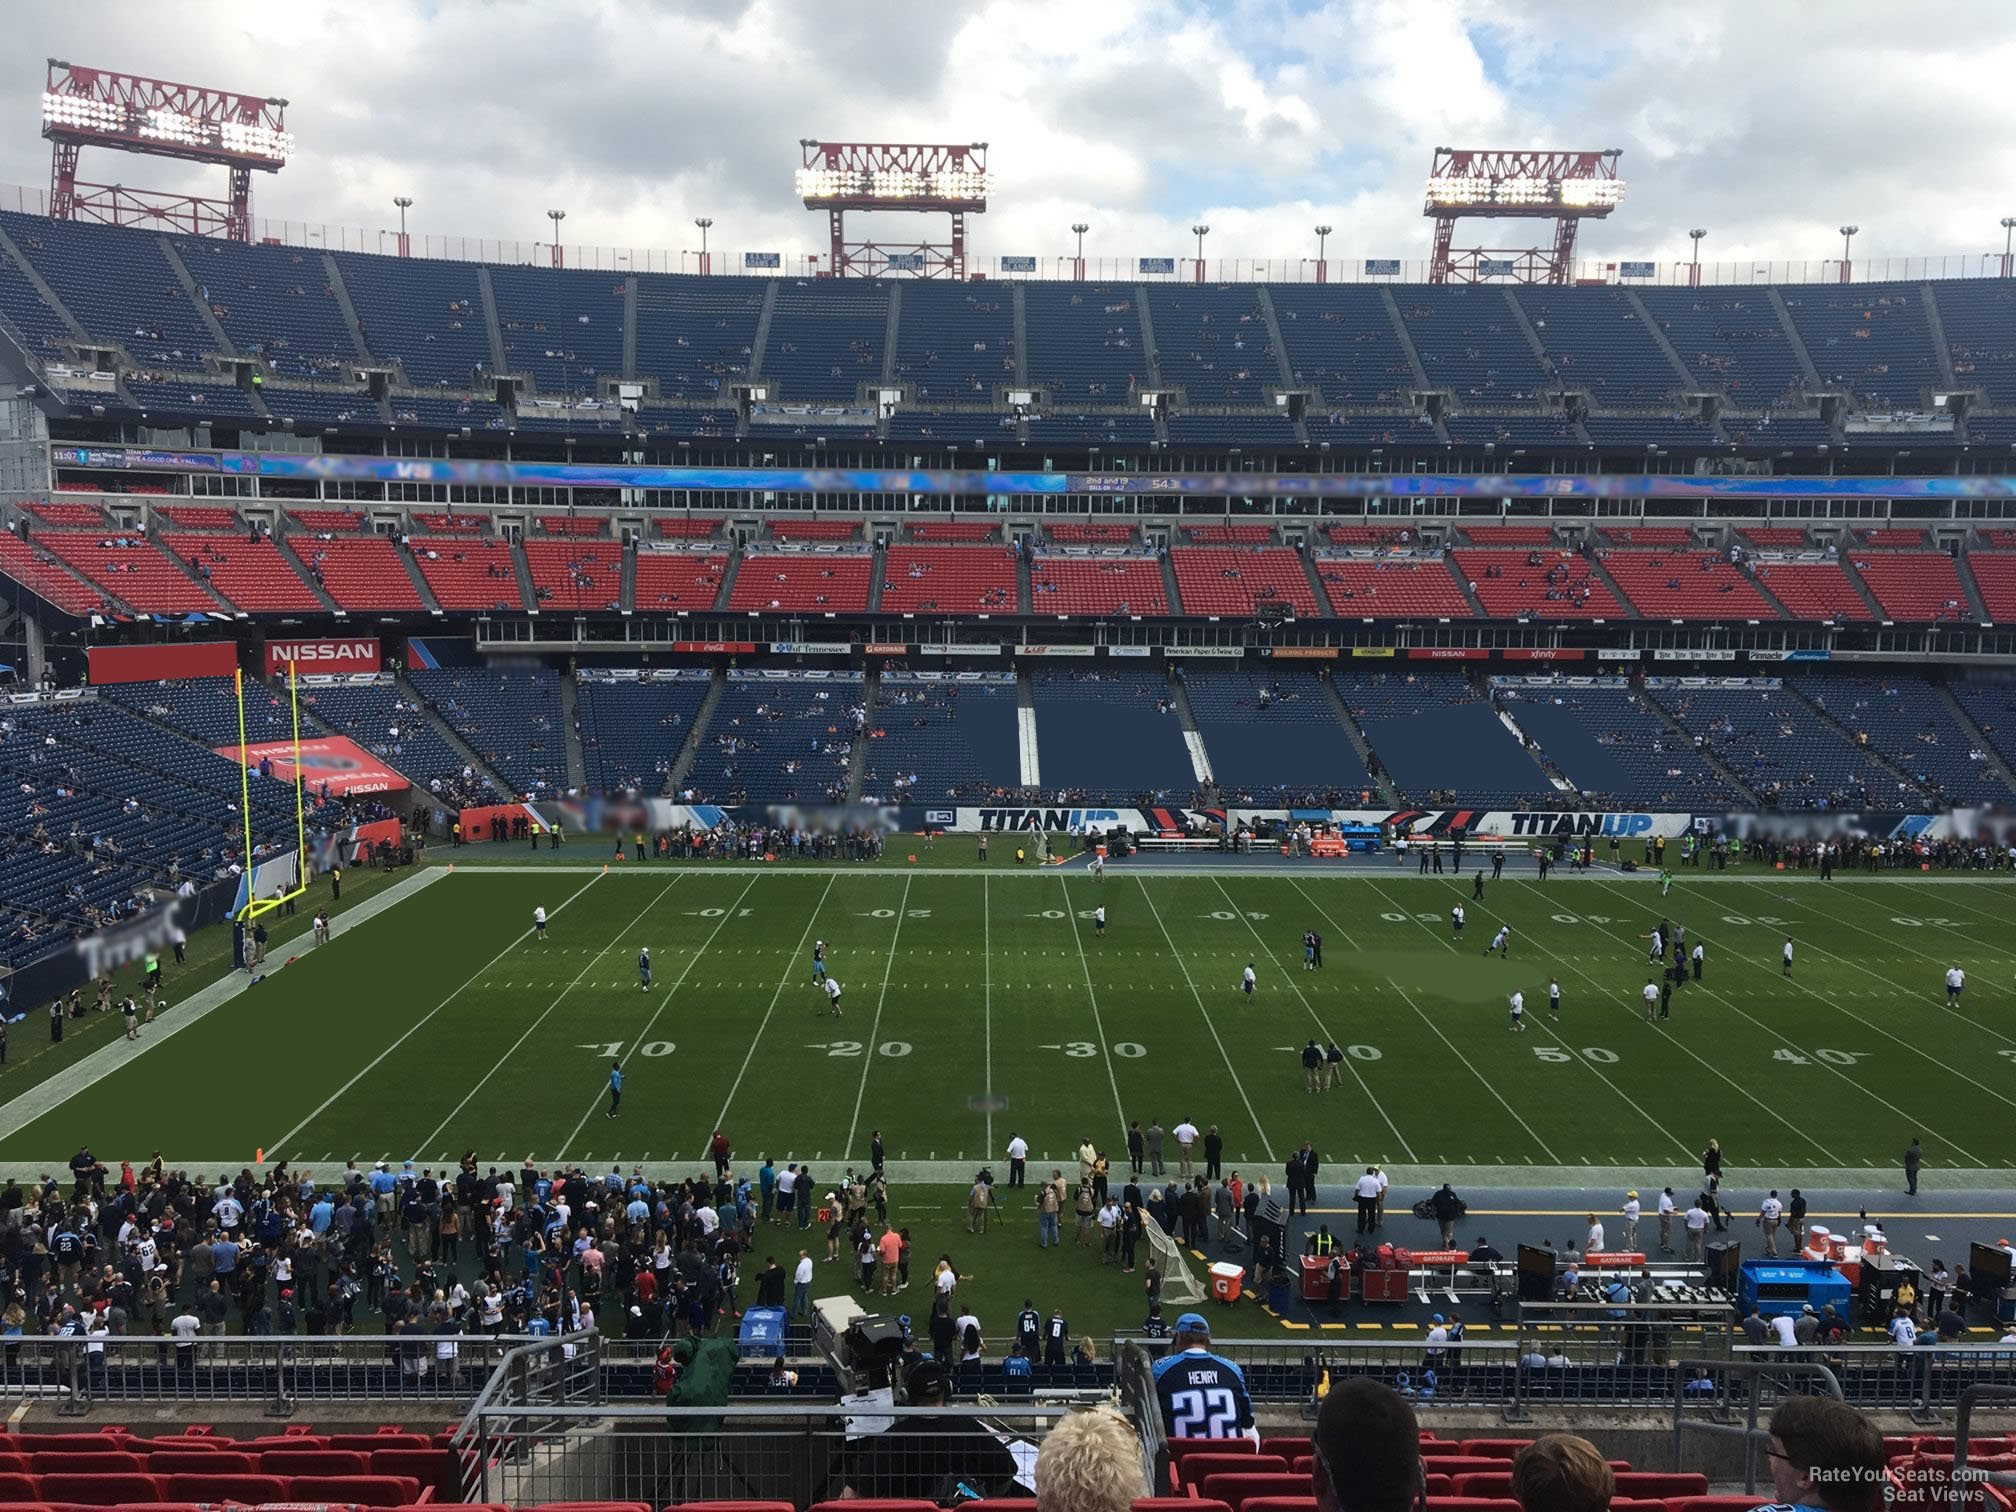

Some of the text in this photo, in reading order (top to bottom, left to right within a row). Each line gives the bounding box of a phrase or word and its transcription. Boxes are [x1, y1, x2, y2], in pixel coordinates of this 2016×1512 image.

[54, 452, 77, 460] 11:07
[272, 644, 374, 660] NISSAN
[792, 644, 845, 653] of Tennessee
[1166, 647, 1192, 655] American
[1194, 647, 1212, 656] Paper
[1530, 650, 1557, 659] xfinity
[1659, 651, 1733, 659] Lite Lite Lite Lite Lite
[1750, 651, 1783, 660] Pinnacle
[251, 744, 330, 756] NISSAN
[344, 782, 388, 792] NISSAN
[938, 812, 951, 820] NFL
[1511, 813, 1653, 836] TITANUP
[1379, 912, 1443, 923] 50
[596, 1040, 677, 1058] 10
[827, 1041, 913, 1058] 20
[1064, 1042, 1148, 1059] 30
[1532, 1046, 1622, 1064] 50
[1772, 1048, 1859, 1066] 40
[224, 1206, 230, 1215] 8
[820, 1210, 830, 1221] 20
[60, 1242, 72, 1252] 22
[141, 1244, 155, 1257] 62
[1216, 1280, 1228, 1294] G
[1023, 1320, 1036, 1332] 84
[1052, 1324, 1061, 1338] 8
[1906, 1326, 1914, 1339] 8
[1188, 1370, 1218, 1385] HENRY
[1171, 1388, 1238, 1438] 22
